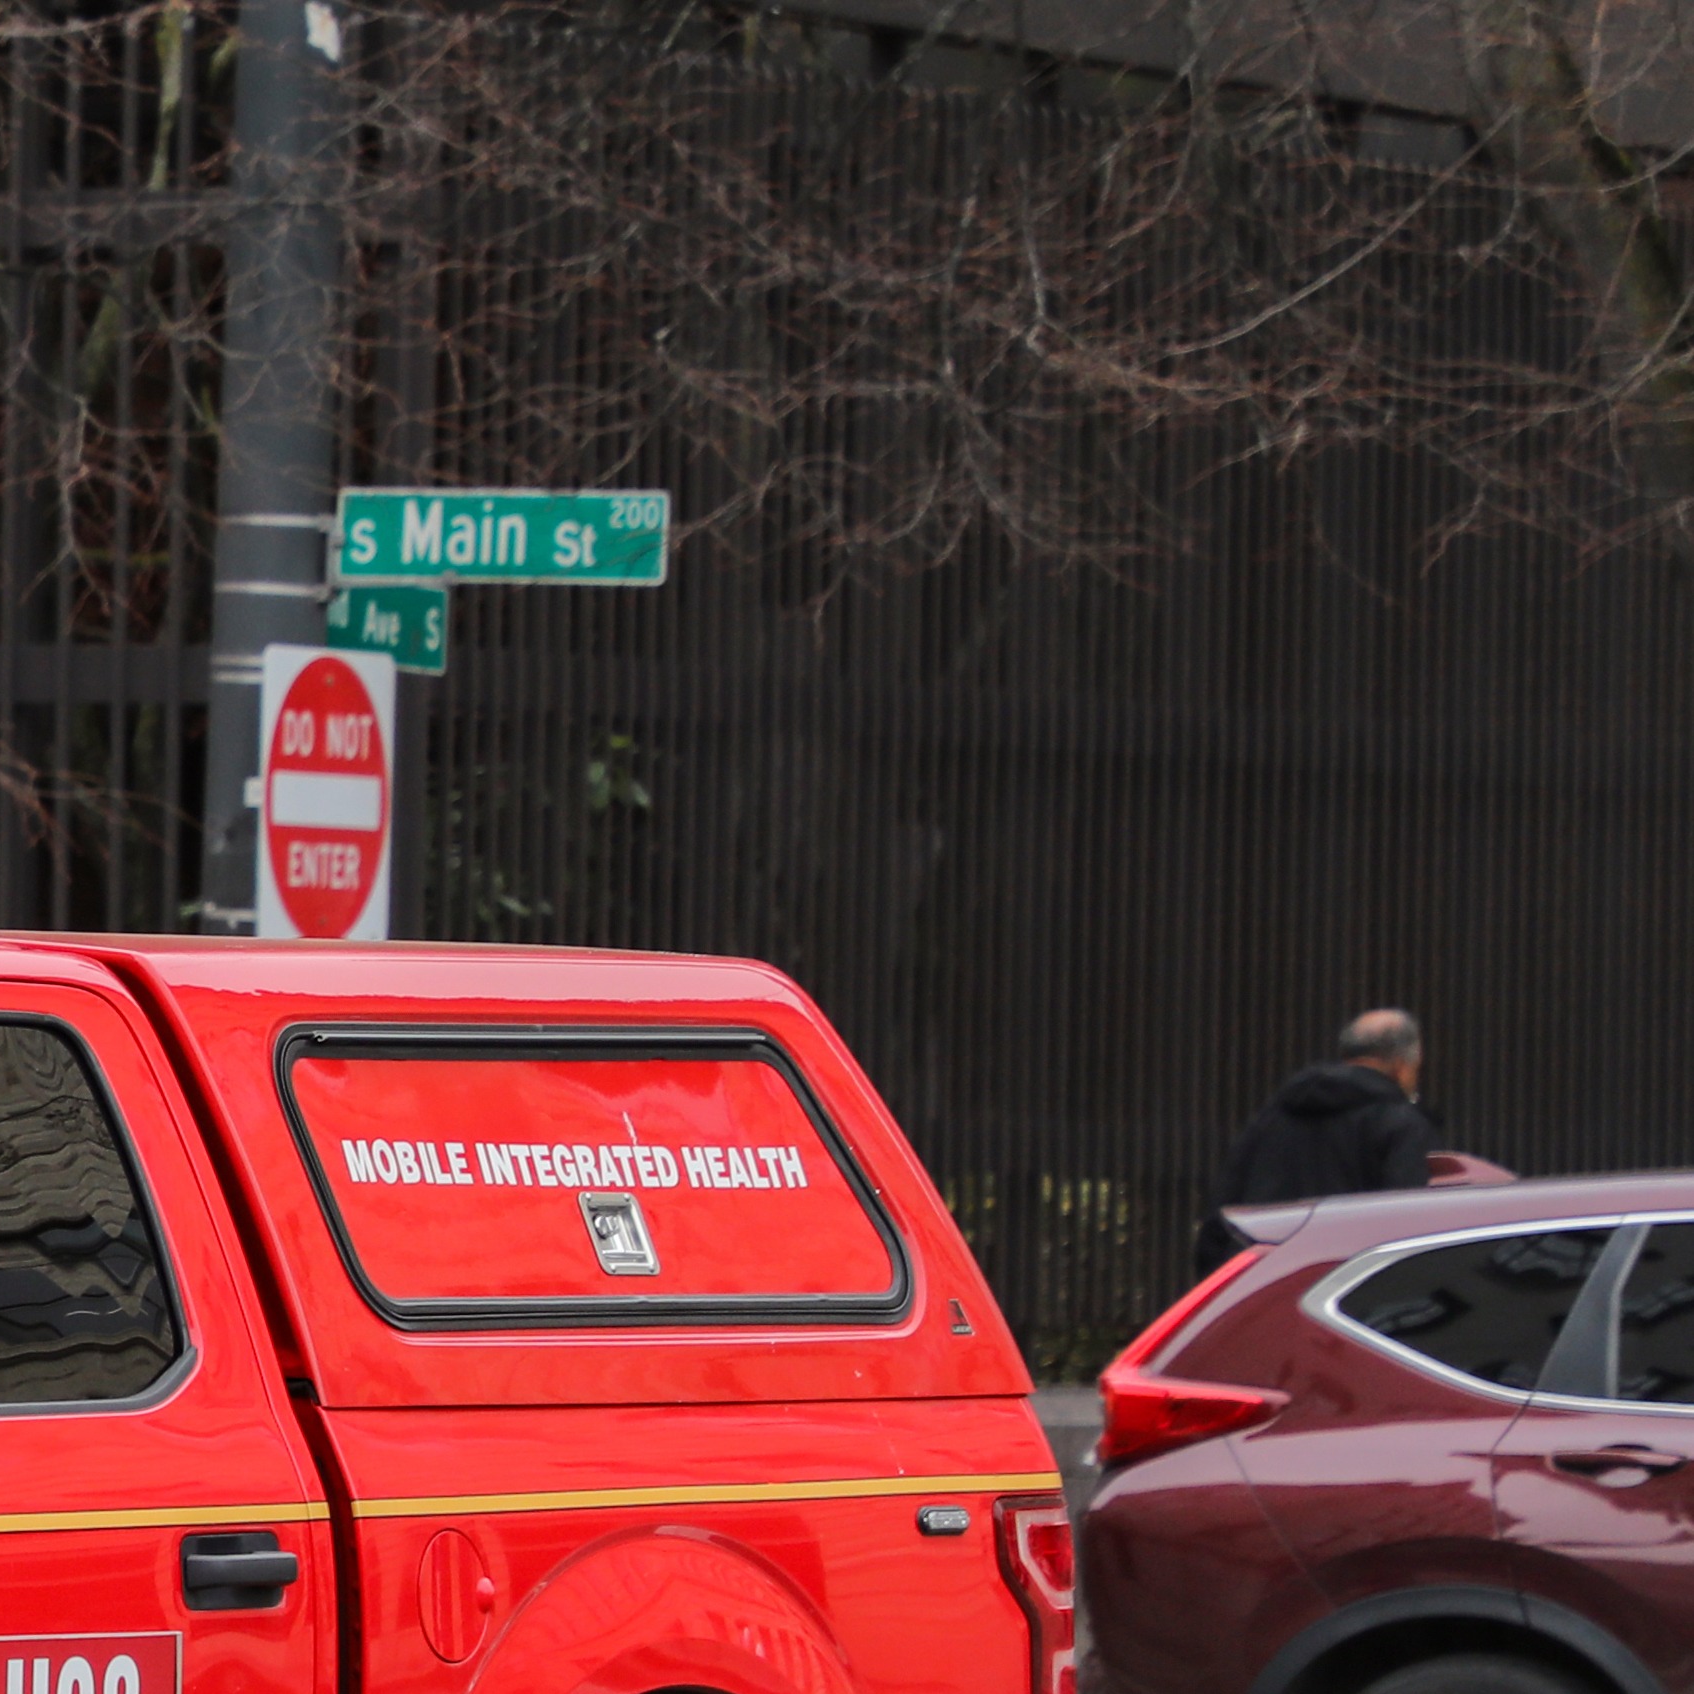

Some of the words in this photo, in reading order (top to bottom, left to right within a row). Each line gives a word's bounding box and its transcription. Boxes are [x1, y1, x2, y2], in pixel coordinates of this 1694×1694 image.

[349, 517, 378, 566] S
[400, 499, 528, 567] Main
[552, 519, 599, 568] St
[609, 499, 661, 530] 200
[362, 600, 401, 647] Ave
[425, 607, 441, 652] S
[282, 709, 315, 758] DO
[325, 712, 373, 761] NOT
[287, 840, 362, 891] ENTER
[341, 1138, 473, 1186] MOBILE
[474, 1142, 680, 1189] INTEGRATED
[681, 1145, 809, 1189] HEALTH
